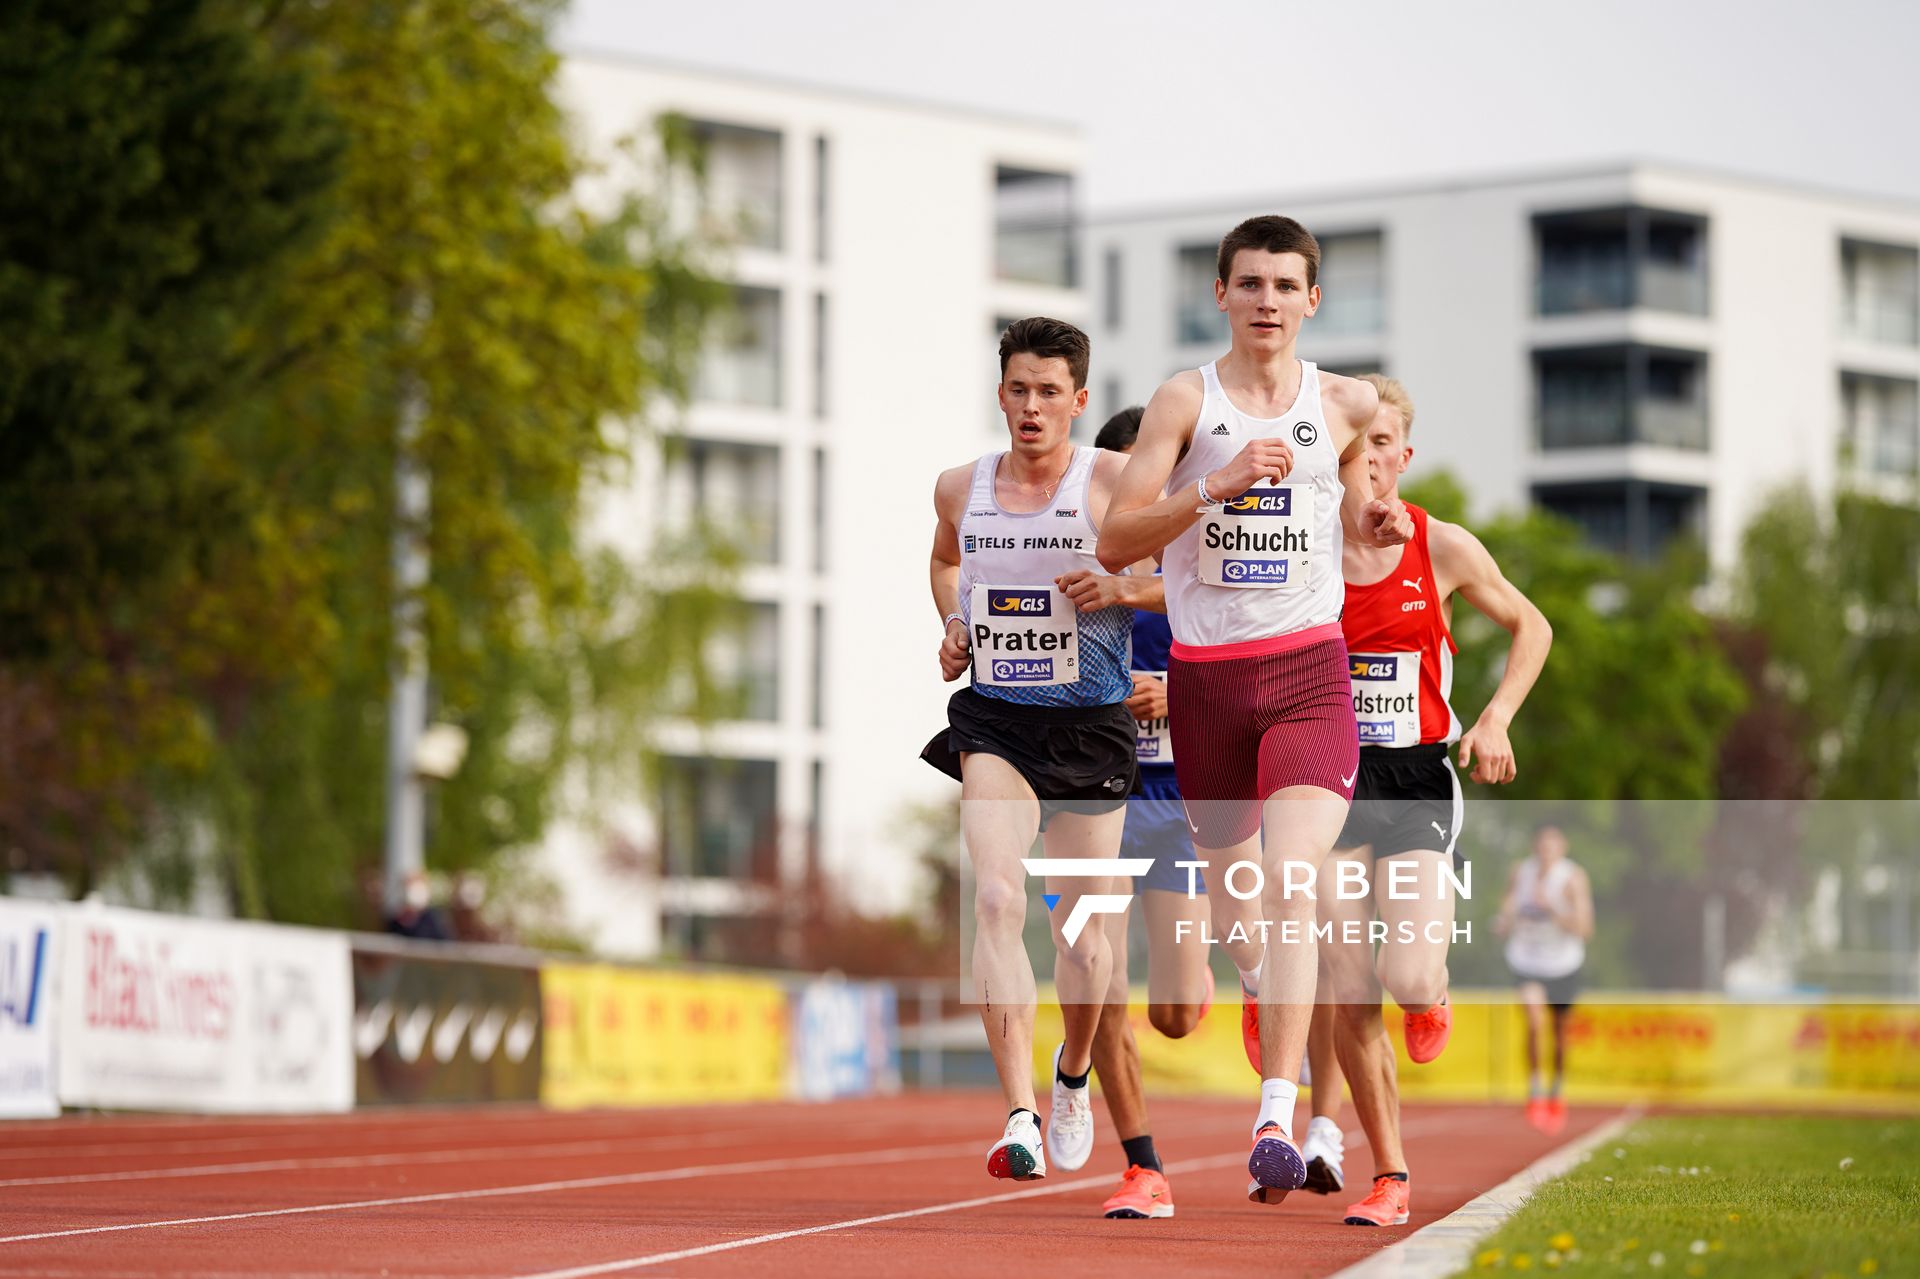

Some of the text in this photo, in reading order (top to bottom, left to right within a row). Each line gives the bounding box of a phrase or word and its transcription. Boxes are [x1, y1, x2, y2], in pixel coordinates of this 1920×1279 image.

[1259, 496, 1286, 511] GLS
[978, 537, 1083, 550] TELIS FINANZ
[1205, 522, 1309, 552] Schucht
[1249, 564, 1286, 575] PLAN
[1020, 598, 1045, 612] GLS
[974, 624, 1073, 651] Prater
[1015, 662, 1051, 673] PLAN
[1067, 657, 1075, 667] 63
[1368, 663, 1393, 677] GLS
[1352, 690, 1415, 713] dstrot
[1359, 725, 1393, 735] PLAN
